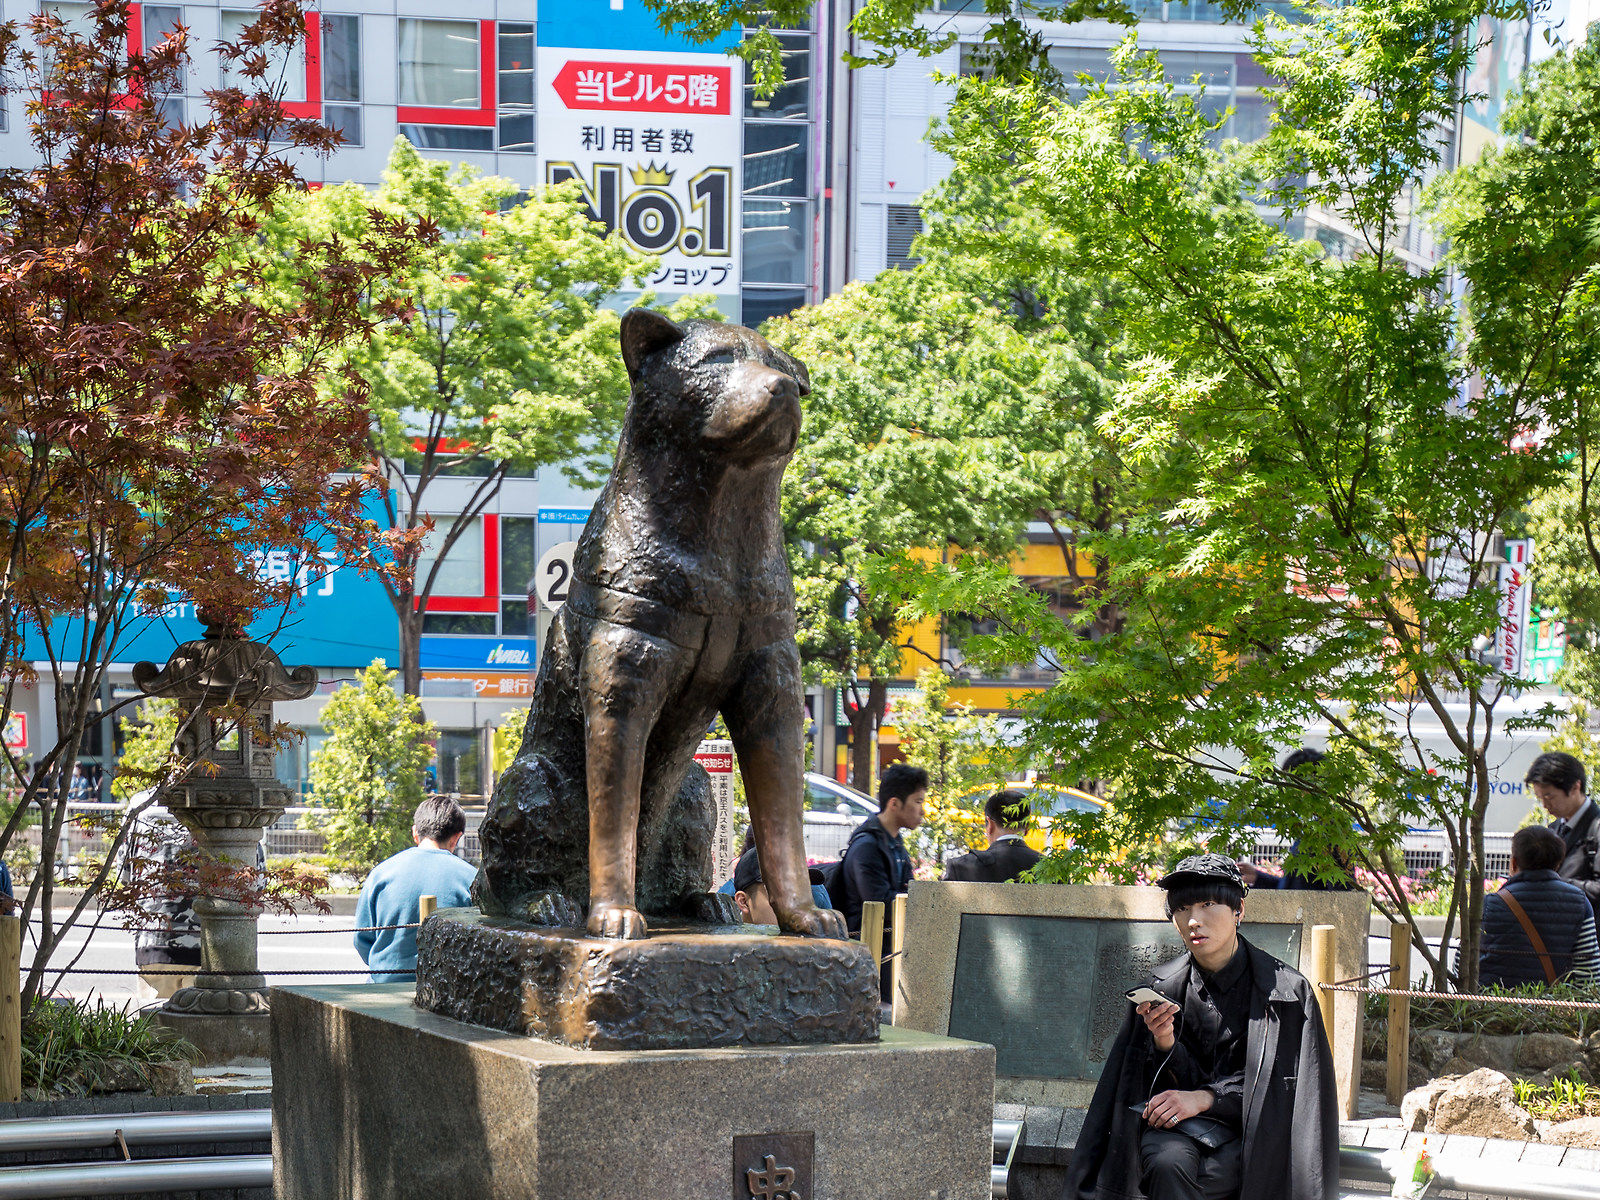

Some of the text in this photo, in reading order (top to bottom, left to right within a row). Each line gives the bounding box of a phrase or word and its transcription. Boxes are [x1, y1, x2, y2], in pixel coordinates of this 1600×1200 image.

[575, 69, 720, 107] 当ビル5階
[582, 126, 695, 154] 利用者数
[546, 160, 733, 257] No.1
